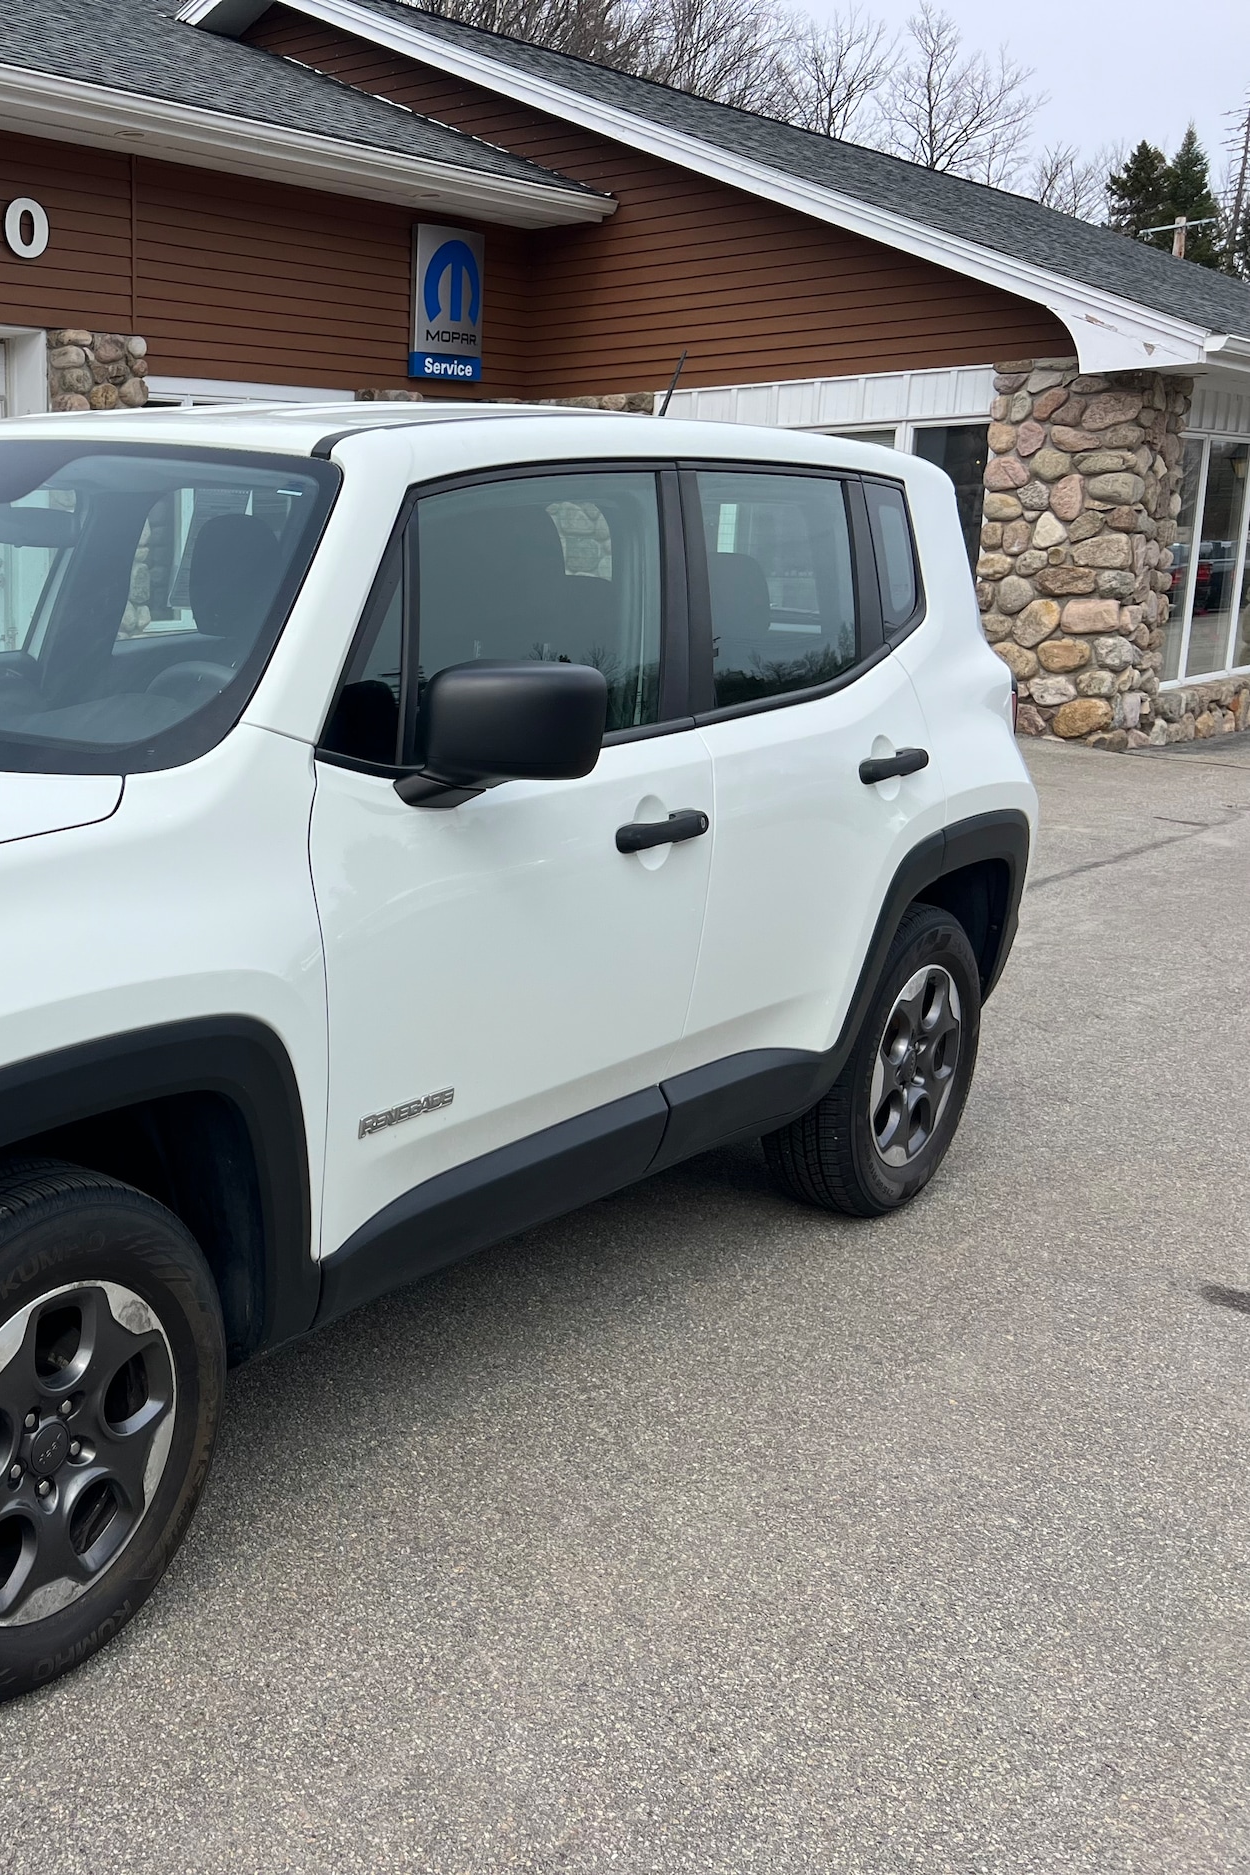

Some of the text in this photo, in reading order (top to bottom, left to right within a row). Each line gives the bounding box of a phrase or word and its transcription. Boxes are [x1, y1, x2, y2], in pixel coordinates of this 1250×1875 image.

[425, 329, 478, 346] MOPAR
[424, 357, 473, 377] Service
[357, 1085, 455, 1140] RENEGADE
